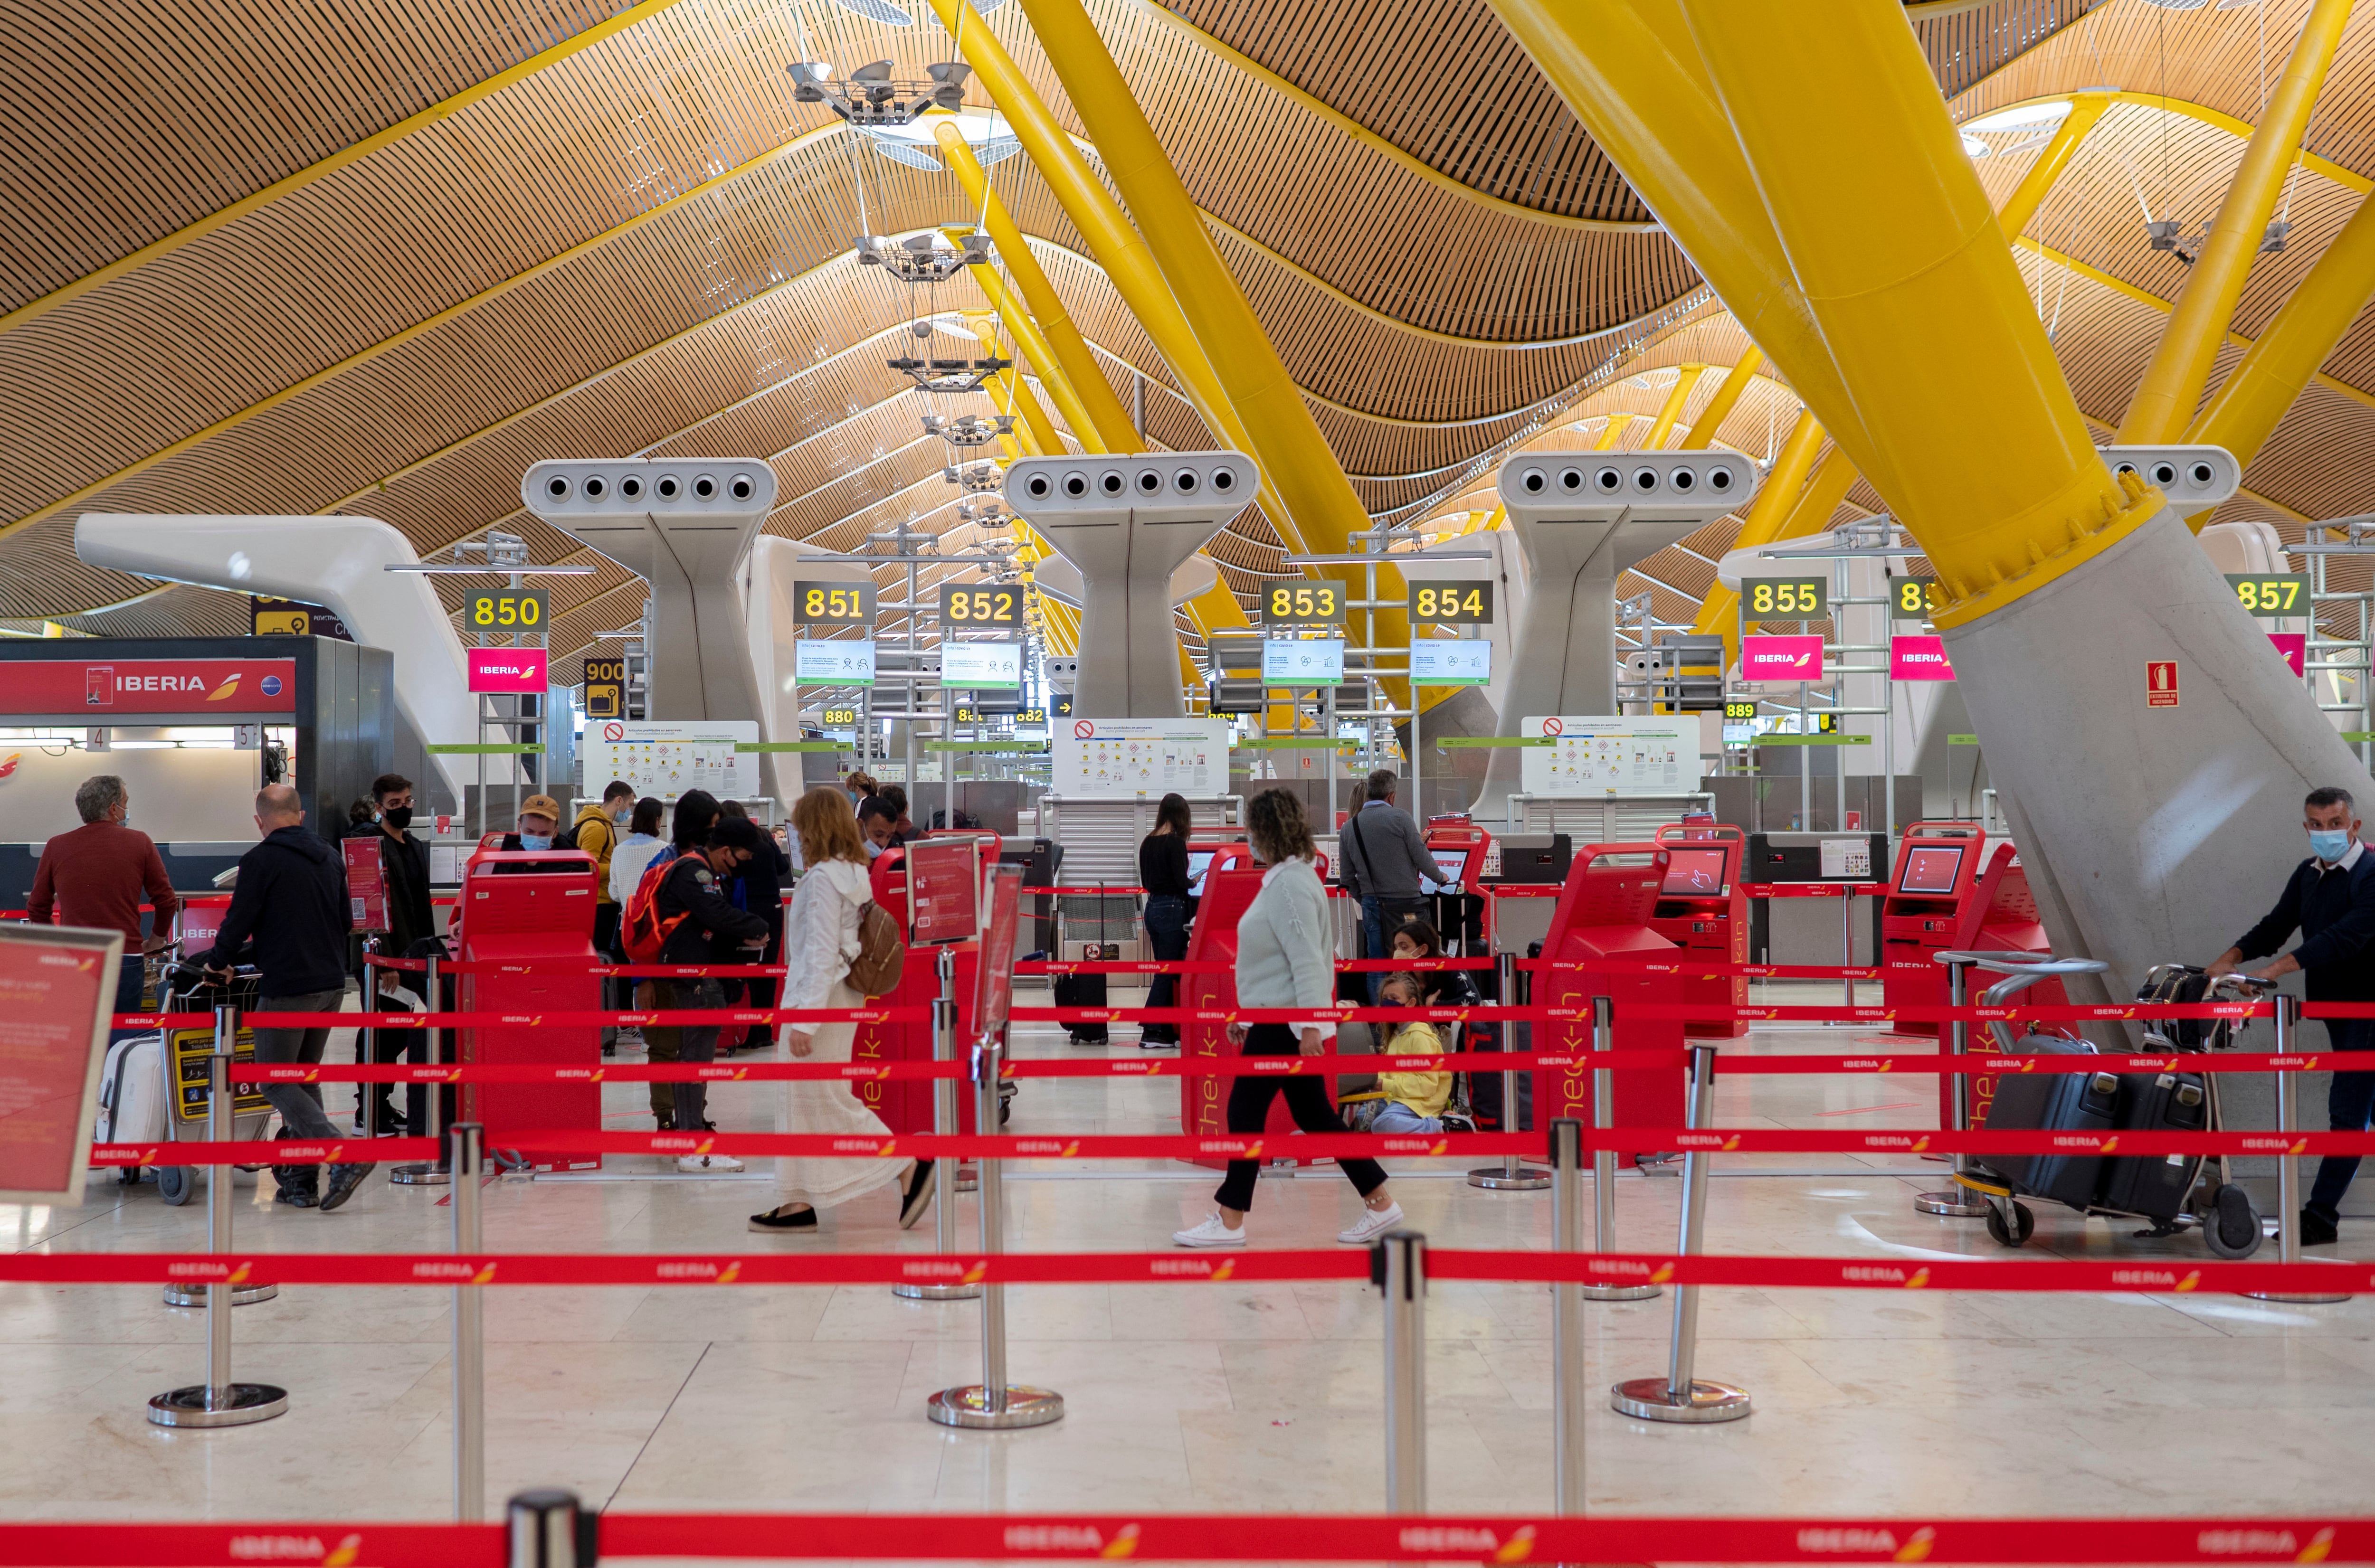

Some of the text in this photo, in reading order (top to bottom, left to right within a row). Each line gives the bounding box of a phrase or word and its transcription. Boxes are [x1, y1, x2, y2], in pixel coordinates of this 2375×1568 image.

[1753, 584, 1817, 613] 855
[2237, 582, 2300, 610] 857
[805, 589, 863, 617] 851
[950, 592, 1012, 620] 852
[1272, 589, 1334, 616] 853
[1417, 589, 1483, 617] 854
[475, 598, 539, 625] 850
[1754, 654, 1794, 662] IBERIA
[1902, 654, 1943, 662] IBERIA
[480, 666, 520, 674] IBERIA
[587, 663, 624, 680] 900
[117, 676, 205, 691] IBERIA
[1727, 704, 1754, 717] 889
[826, 711, 853, 723] 880
[95, 728, 103, 747] 4
[240, 725, 247, 745] 5
[183, 929, 218, 938] IBER
[651, 1138, 696, 1148] IBERIA
[834, 1140, 878, 1150] IBERIA
[1384, 1140, 1430, 1150] IBERIA
[1677, 1135, 1723, 1145] IBERIA
[1865, 1136, 1911, 1145] IBERIA
[2054, 1137, 2100, 1146] IBERIA
[2242, 1139, 2289, 1148] IBERIA
[280, 1147, 325, 1157] IBERIA
[1016, 1142, 1062, 1152] IBERIA
[1200, 1142, 1245, 1152] IBERIA
[95, 1149, 139, 1159] IBERIA
[169, 1263, 228, 1275] IBERIA
[413, 1264, 473, 1276] IBERIA
[657, 1264, 717, 1276] IBERIA
[903, 1263, 963, 1276] IBERIA
[1151, 1261, 1211, 1274] IBERIA
[1589, 1260, 1650, 1275] IBERIA
[1843, 1267, 1905, 1281] IBERIA
[2112, 1271, 2175, 1284] IBERIA
